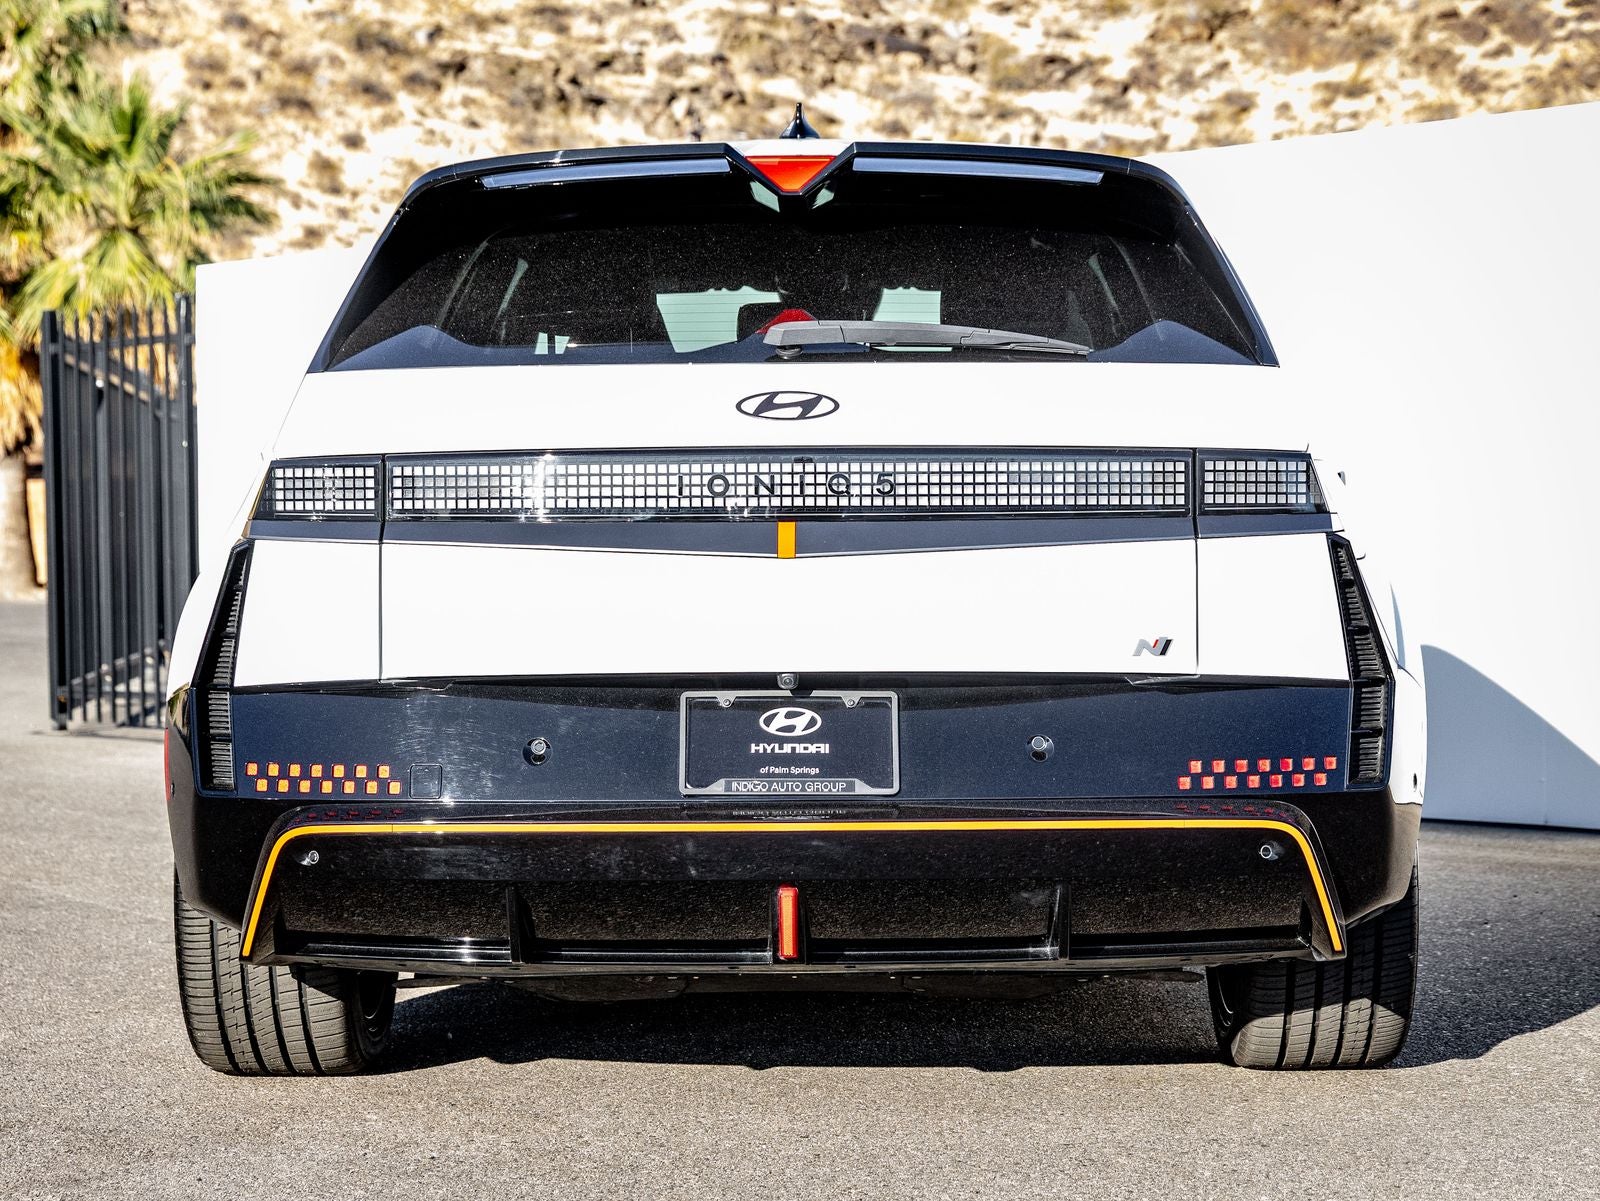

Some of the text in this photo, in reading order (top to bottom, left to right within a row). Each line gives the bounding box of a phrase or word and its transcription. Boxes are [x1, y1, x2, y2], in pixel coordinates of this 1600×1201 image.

[677, 472, 895, 497] IONIQ 5
[750, 743, 830, 754] HYUNDAI
[769, 766, 789, 774] Palm
[790, 766, 820, 775] Springs
[731, 781, 847, 793] INDIGO AUTO GROUP
